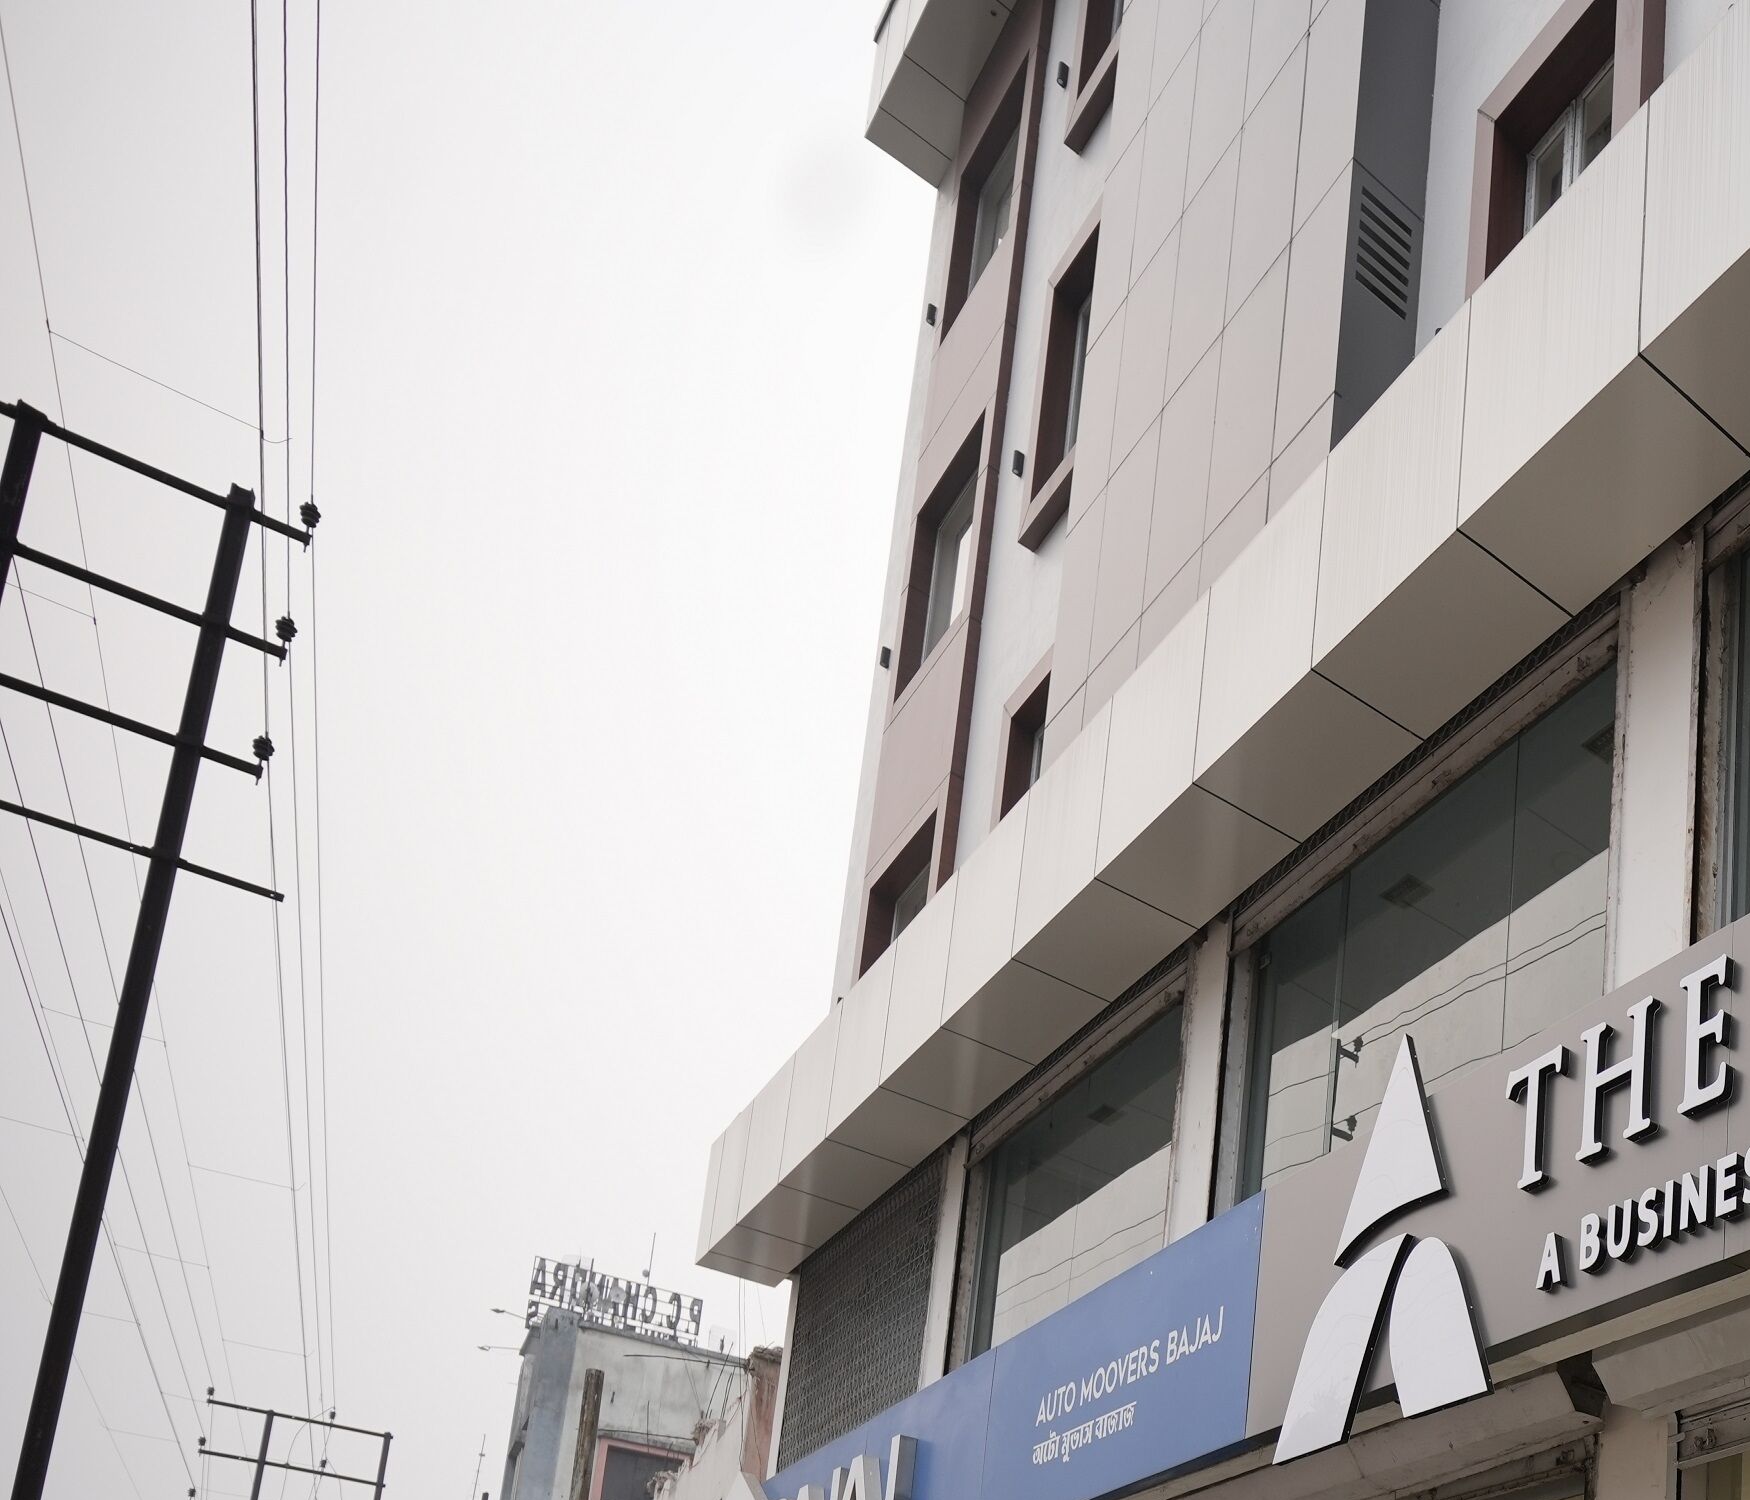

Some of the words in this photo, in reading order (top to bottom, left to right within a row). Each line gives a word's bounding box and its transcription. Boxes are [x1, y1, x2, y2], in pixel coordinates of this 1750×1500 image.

[1506, 953, 1733, 1192] THE
[1536, 1232, 1567, 1291] A
[1036, 1382, 1076, 1427] AUTO
[1080, 1339, 1160, 1406] MOOVERS
[1166, 1306, 1224, 1365] BAJAJ
